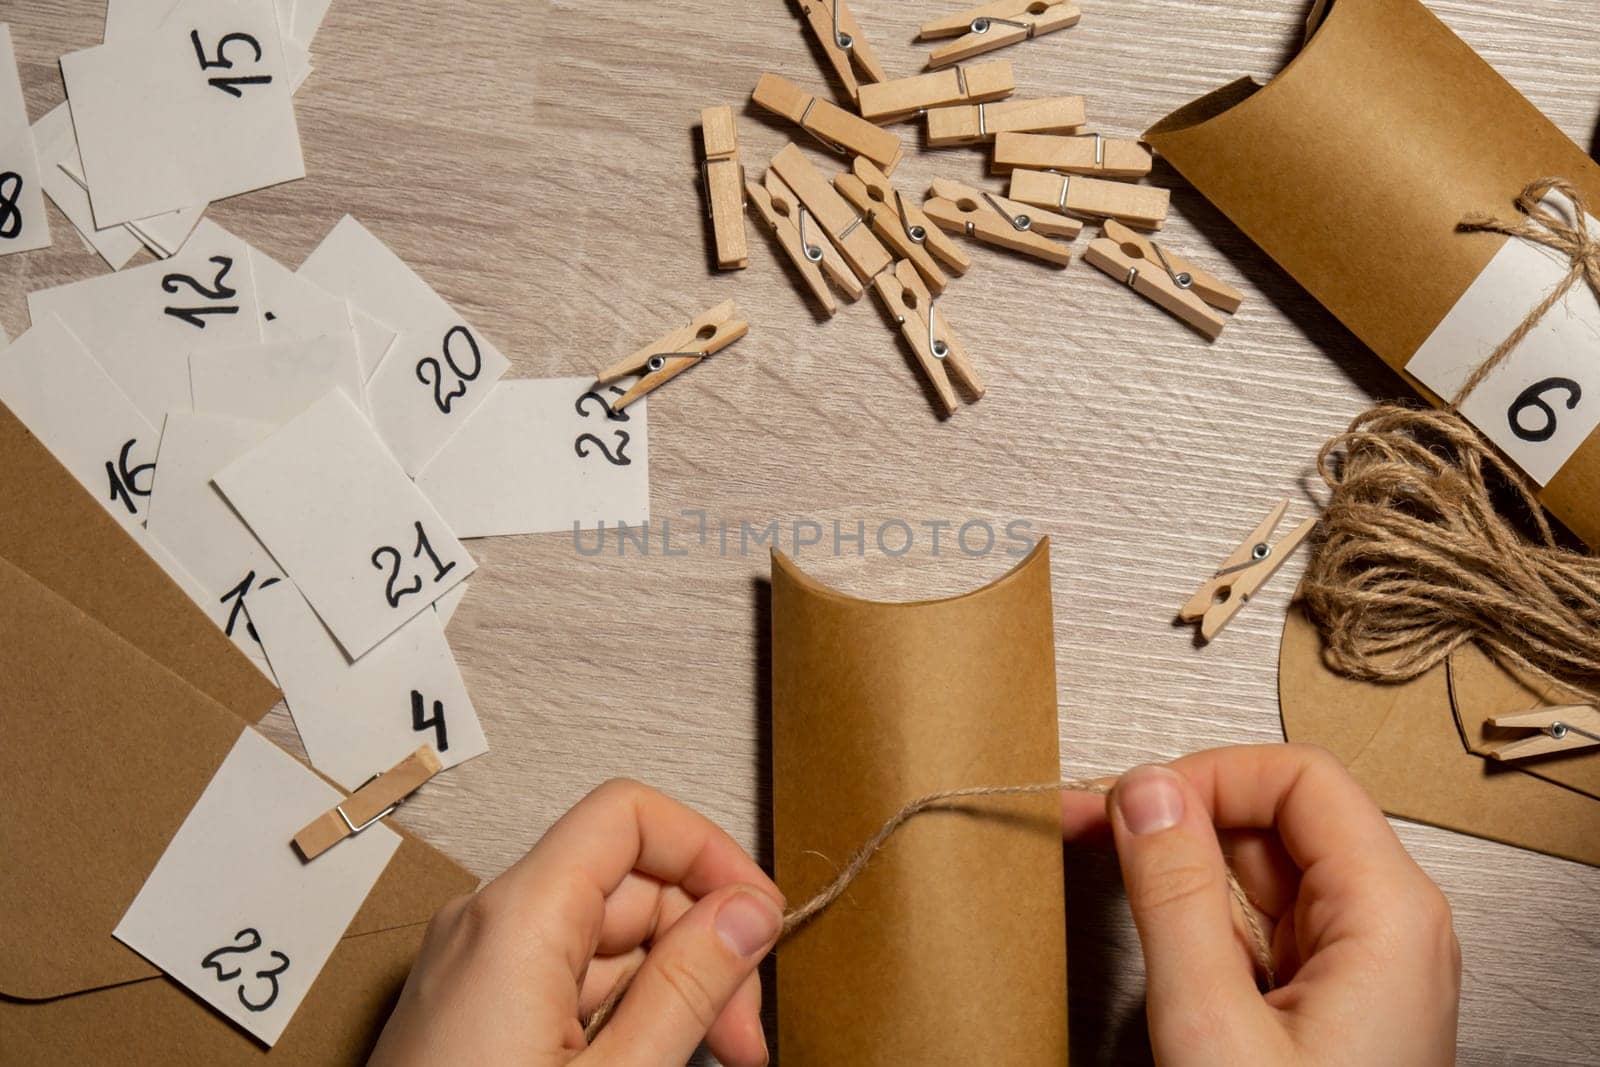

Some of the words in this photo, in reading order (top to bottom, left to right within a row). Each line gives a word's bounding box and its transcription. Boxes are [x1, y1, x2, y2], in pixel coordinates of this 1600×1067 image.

[191, 29, 274, 99] 15
[161, 255, 240, 329] 12
[415, 325, 483, 415] 20
[574, 369, 632, 467] 22
[1507, 377, 1582, 443] 6
[371, 521, 457, 609] 21
[220, 569, 282, 648] 1
[410, 690, 449, 753] 4
[201, 927, 291, 1013] 23
